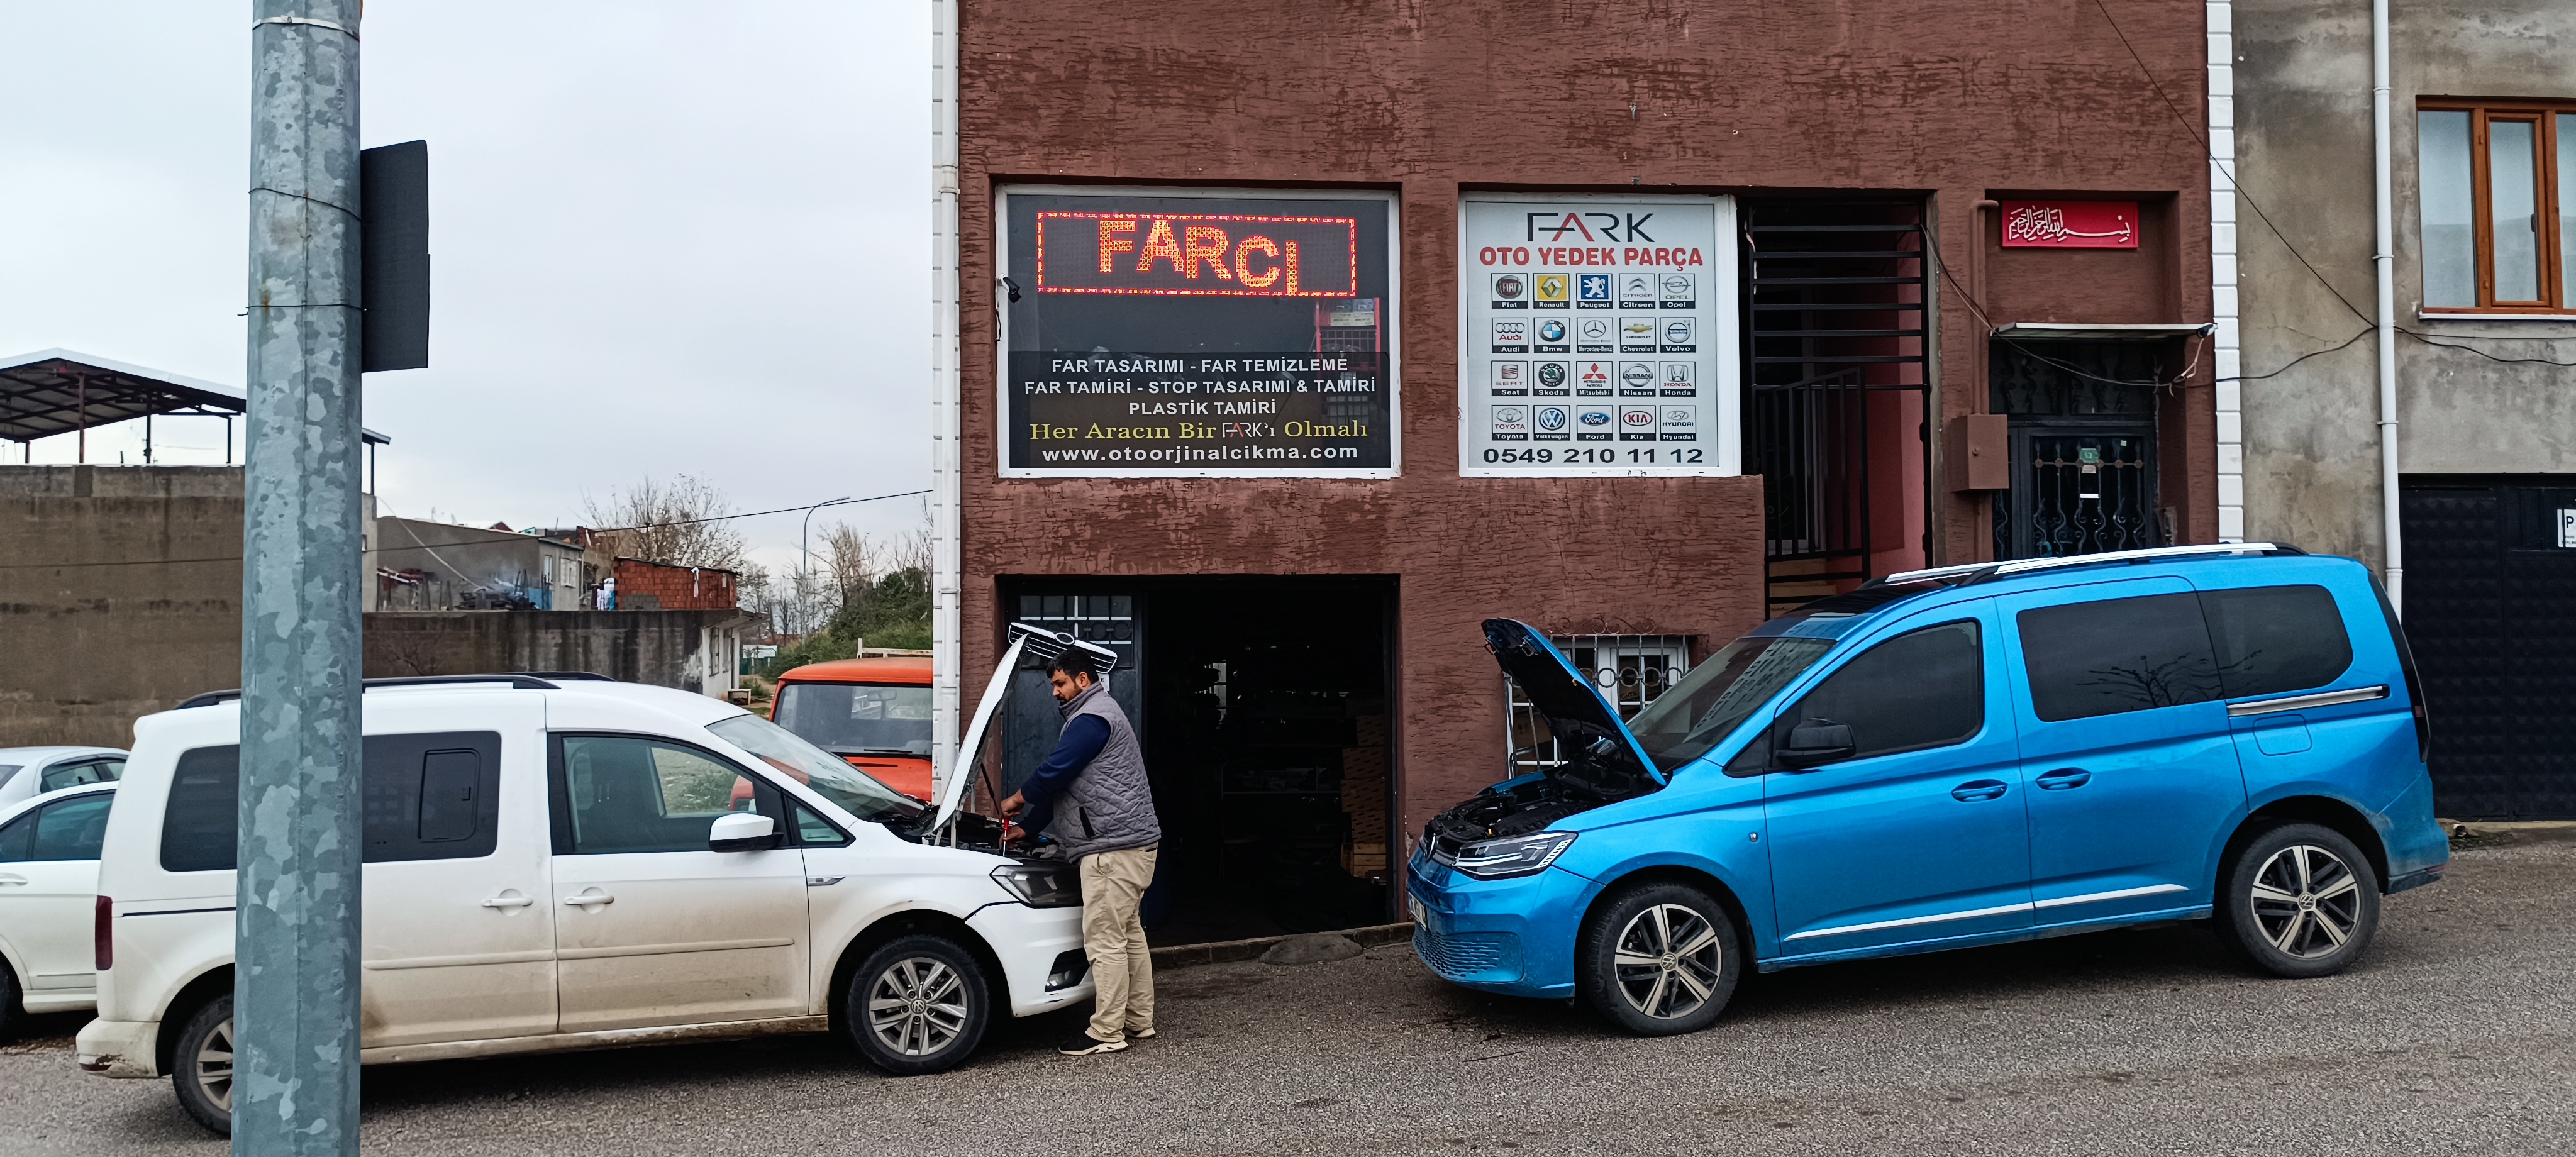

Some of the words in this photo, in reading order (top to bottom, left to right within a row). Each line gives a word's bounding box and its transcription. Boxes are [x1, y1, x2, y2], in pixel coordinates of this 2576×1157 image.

[1527, 213, 1655, 242] FARK
[1099, 219, 1298, 294] FARCI
[1480, 247, 1530, 265] OTO
[1538, 247, 1616, 265] YEDEK
[1624, 248, 1702, 271] PARÇA
[1503, 283, 1517, 292] FIAT
[1053, 360, 1089, 372] FAR
[1095, 360, 1183, 372] TASARIMI
[1202, 360, 1236, 372] FAR
[1243, 357, 1347, 371] TEMİZLEME
[1025, 382, 1061, 394] FAR
[1067, 379, 1130, 393] TAMİRİ
[1149, 382, 1197, 393] STOP
[1203, 380, 1289, 393] TASARIMI
[1297, 380, 1307, 392] &
[1314, 376, 1374, 392] TAMİRİ
[1130, 400, 1208, 414] PLASTİK
[1214, 399, 1275, 414] TAMİRİ
[1030, 423, 1078, 440] Her
[1085, 423, 1170, 439] Aracın
[1179, 423, 1216, 438] Bir
[1284, 421, 1368, 437] Olmalı
[1042, 445, 1357, 463] www.otoorjinalcikma.com
[1484, 449, 1552, 463] 0549
[1564, 449, 1614, 463] 210
[1628, 449, 1654, 463] 11
[1671, 449, 1702, 463] 12
